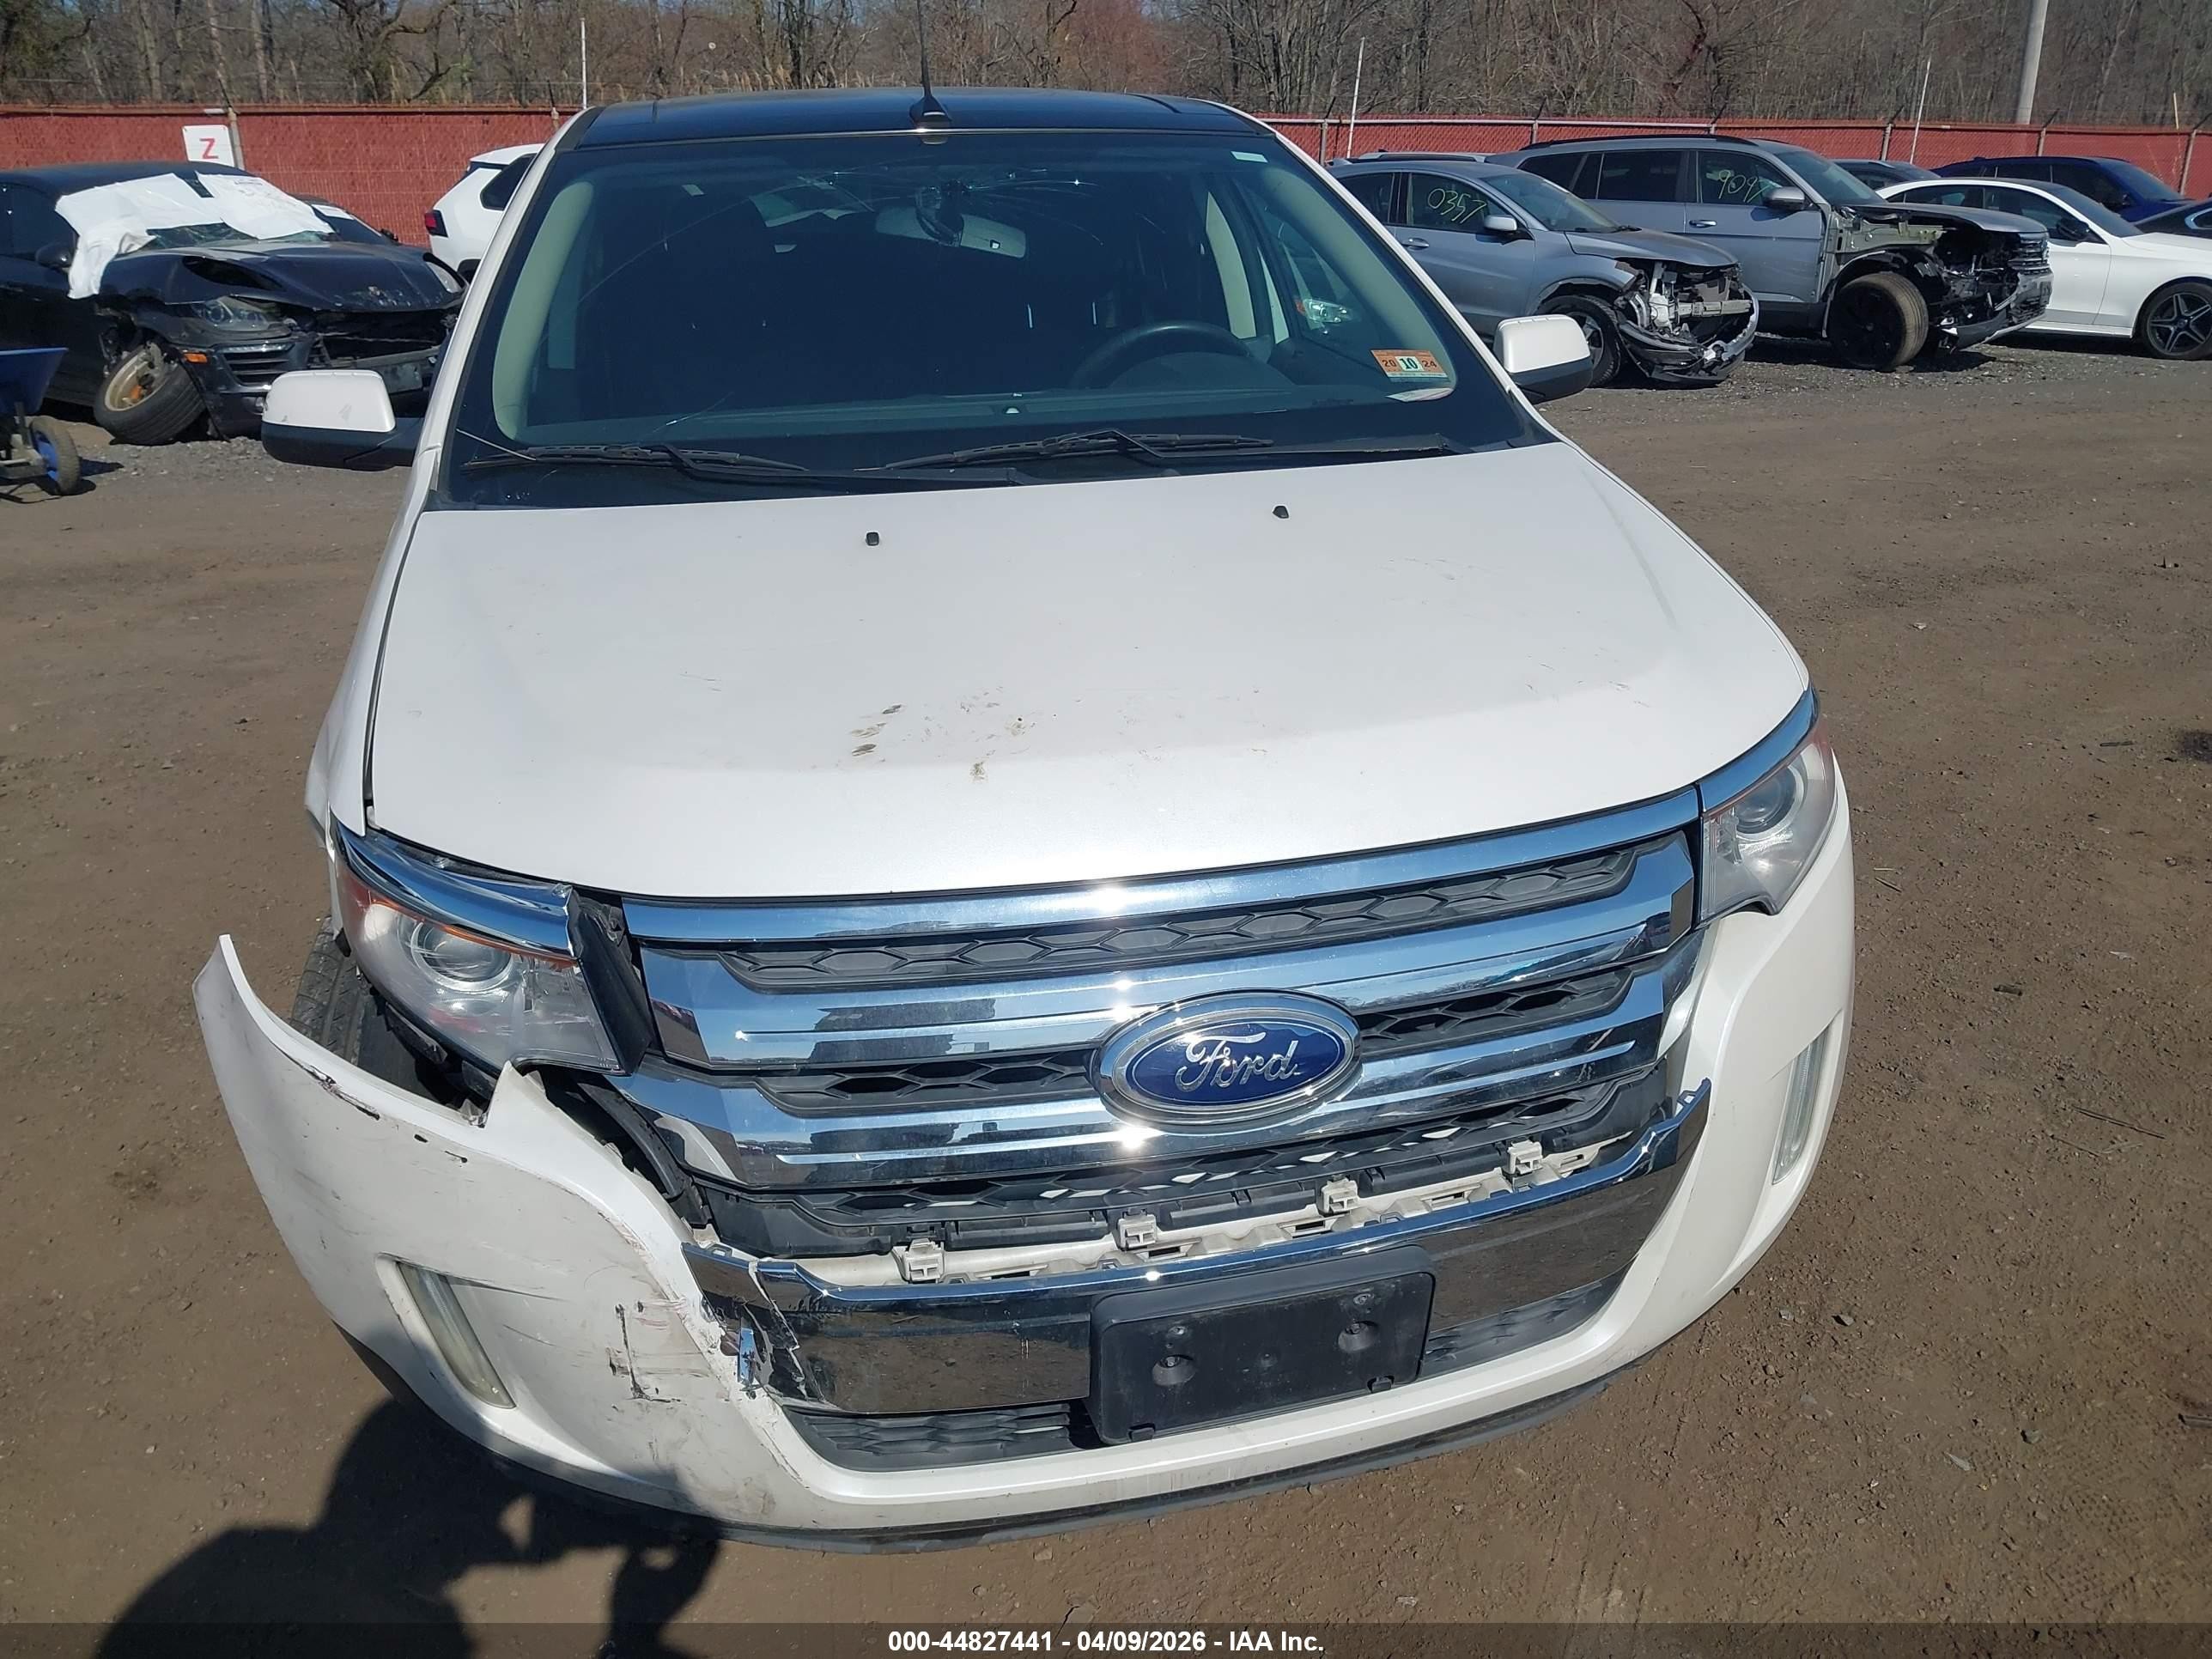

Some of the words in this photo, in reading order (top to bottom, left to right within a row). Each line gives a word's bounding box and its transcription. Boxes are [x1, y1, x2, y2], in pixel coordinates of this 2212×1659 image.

[199, 137, 219, 160] Z
[1427, 188, 1488, 224] 0357
[1382, 359, 1397, 368] 20
[1399, 357, 1419, 369] 10
[1421, 360, 1437, 368] 24
[1175, 1031, 1300, 1093] Ford
